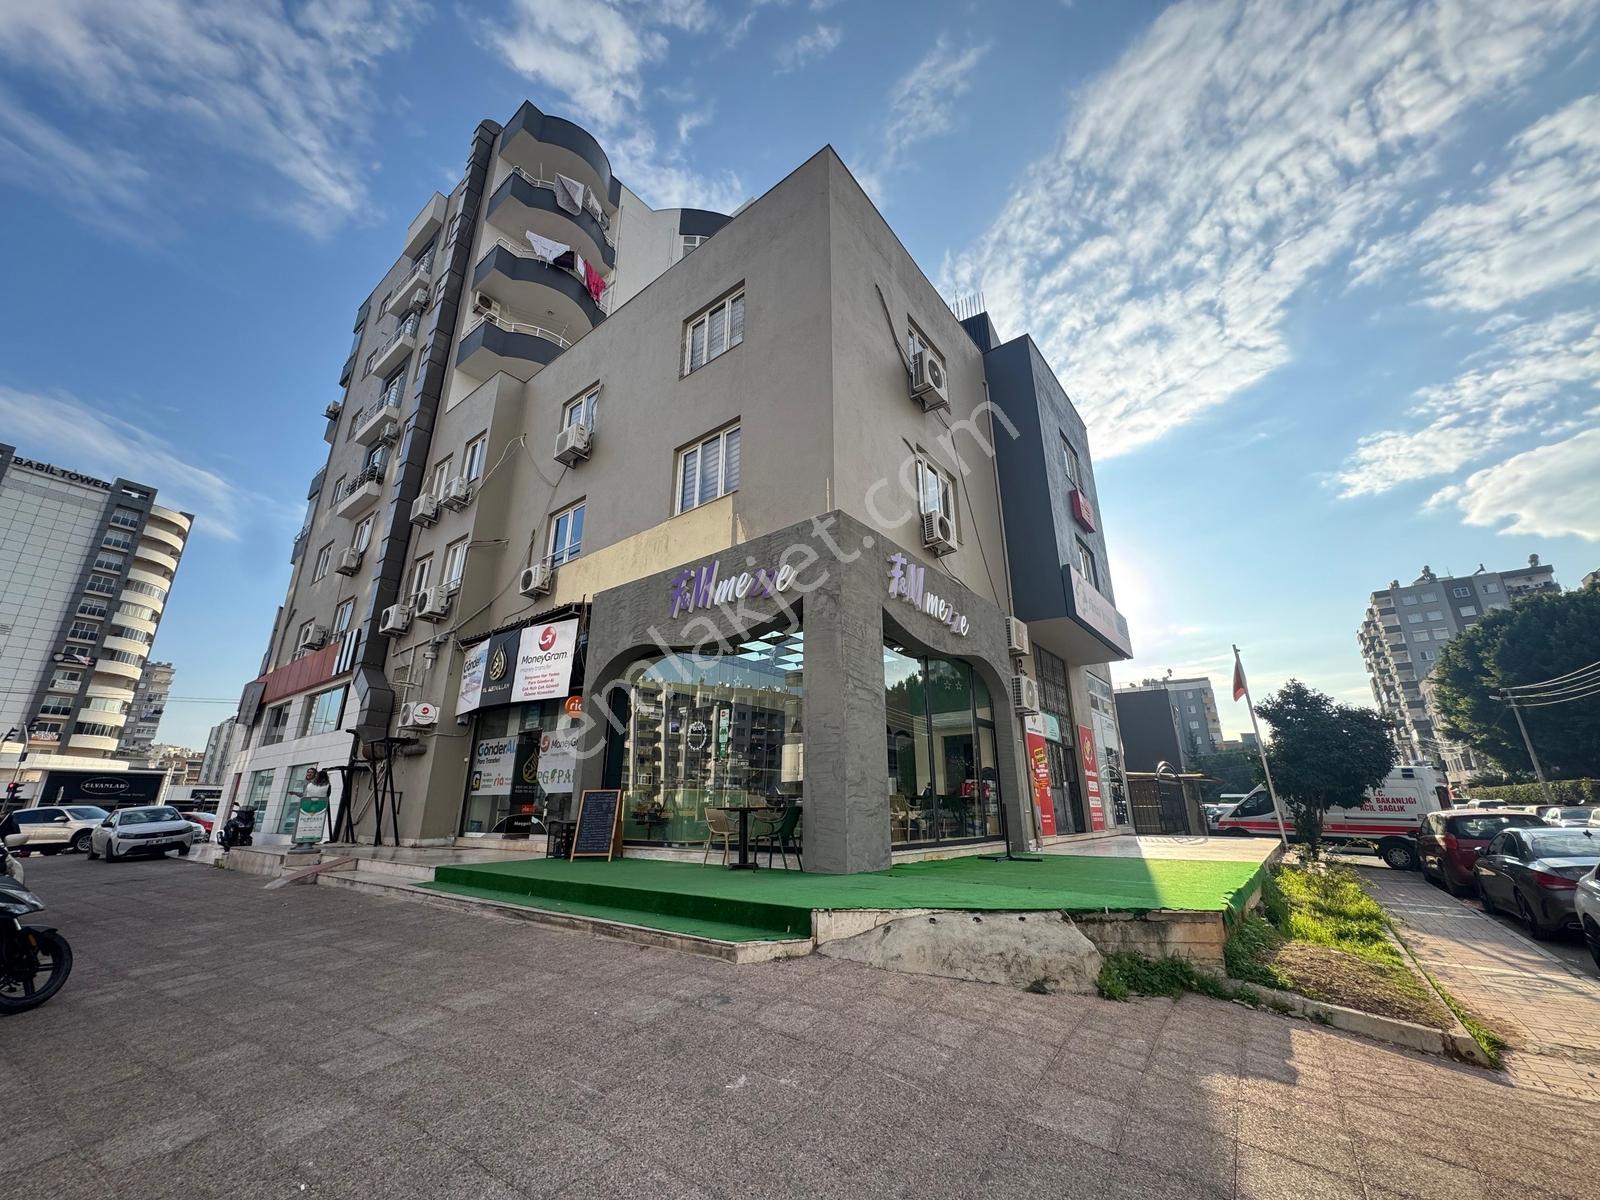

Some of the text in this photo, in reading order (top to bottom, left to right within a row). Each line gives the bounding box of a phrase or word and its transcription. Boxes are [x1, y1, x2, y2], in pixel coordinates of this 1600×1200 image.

[13, 455, 112, 490] BABİL TOWER
[521, 650, 567, 665] MoneyGram
[478, 739, 517, 757] GönderAl
[1378, 804, 1406, 812] SAĞLIK
